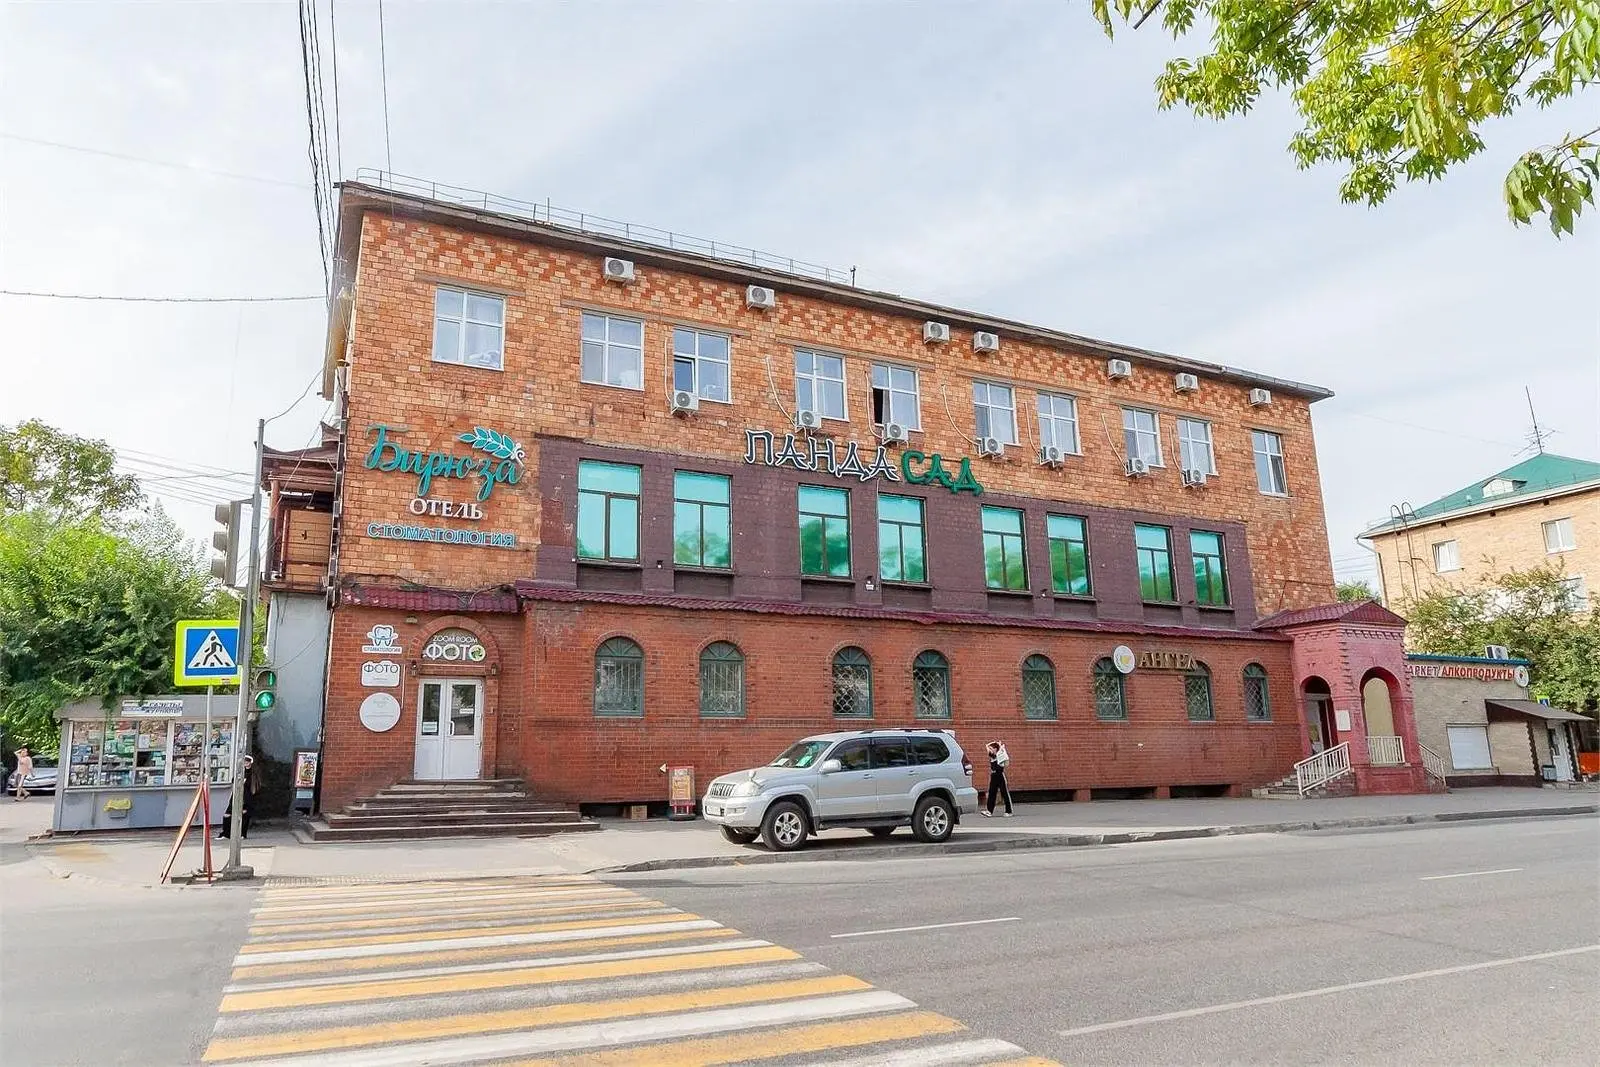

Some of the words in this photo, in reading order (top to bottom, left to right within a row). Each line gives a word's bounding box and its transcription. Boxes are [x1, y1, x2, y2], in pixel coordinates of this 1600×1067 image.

[364, 423, 526, 501] Бирюза
[745, 429, 900, 482] ПАНДА
[901, 450, 984, 495] САД
[409, 498, 484, 520] ОТЕЛЬ
[367, 523, 515, 547] СТОМАТОЛОГИЯ
[426, 641, 486, 662] ФОТО
[364, 664, 398, 673] ФОТО
[1441, 665, 1515, 680] АЛКОПРОДУКТЫ
